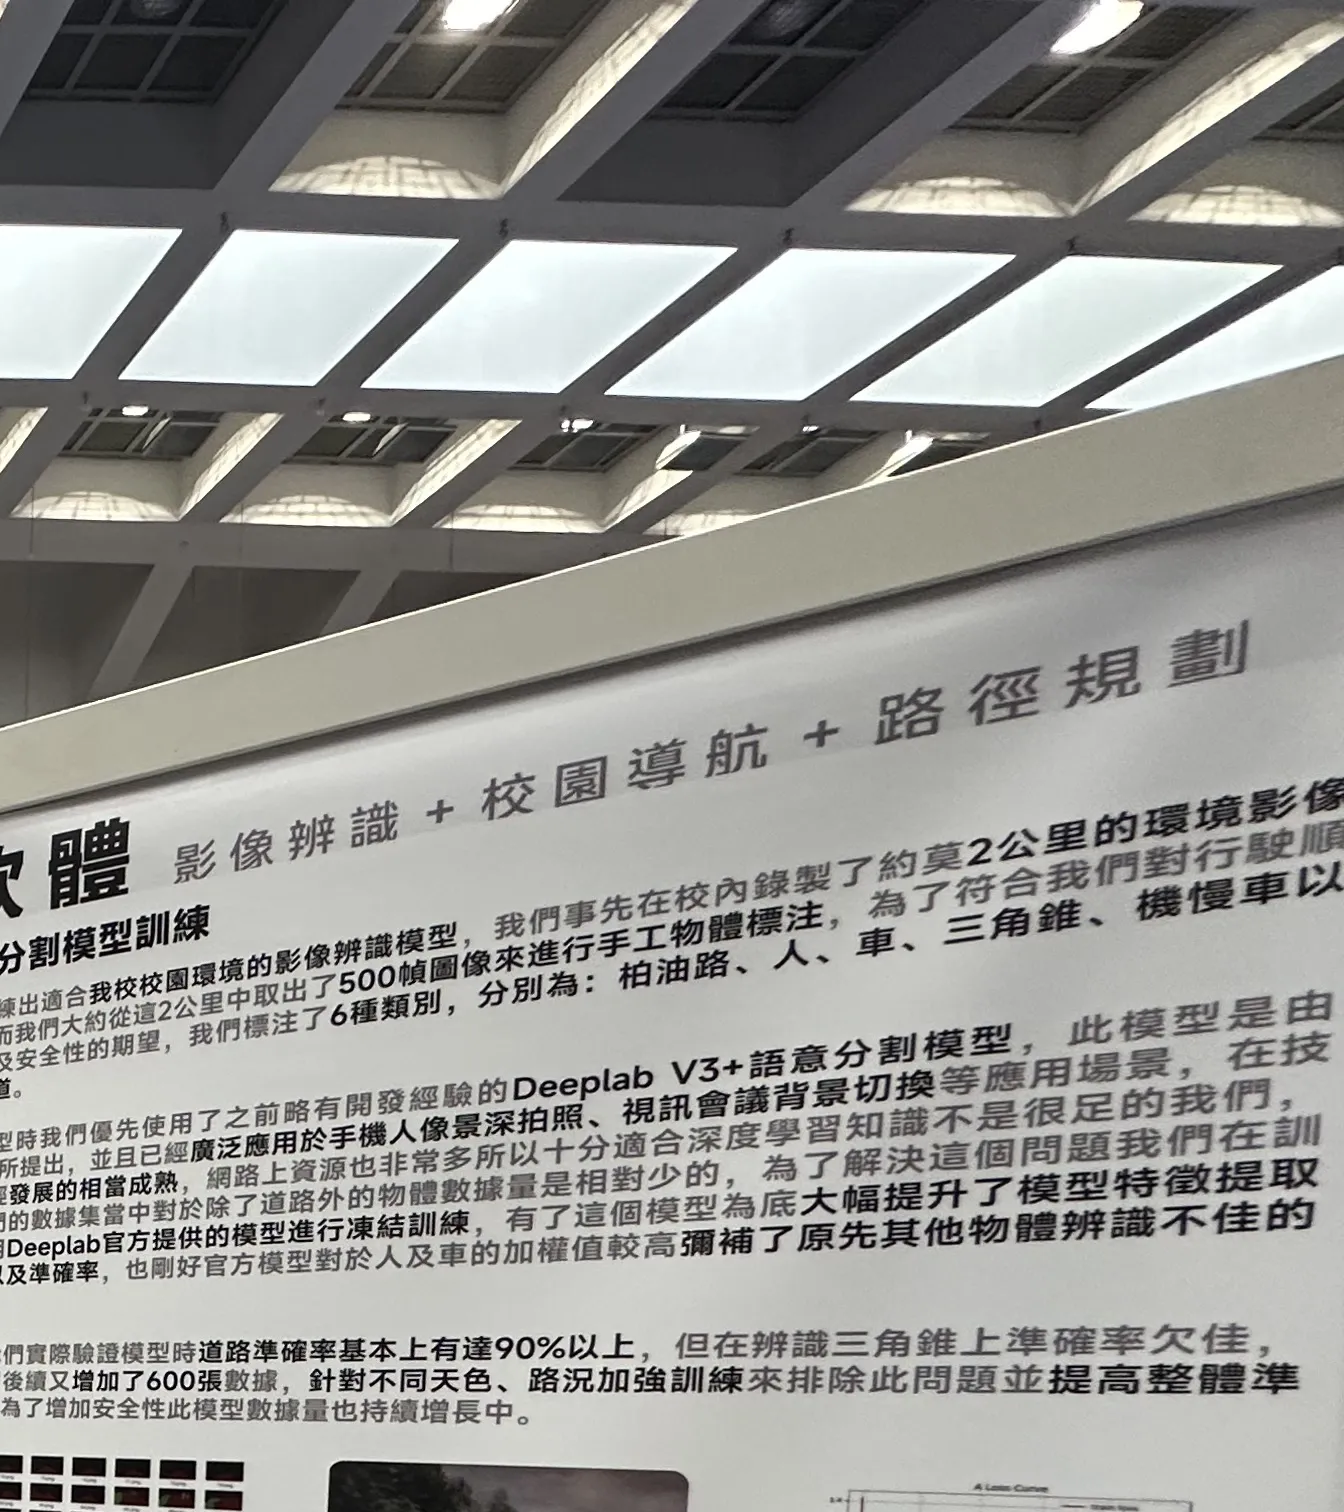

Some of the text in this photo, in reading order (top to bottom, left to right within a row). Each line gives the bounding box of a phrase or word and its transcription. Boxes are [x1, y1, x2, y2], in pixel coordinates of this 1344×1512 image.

[174, 799, 399, 888] 影像辨識
[483, 724, 769, 823] 校園導航
[873, 619, 1252, 746] 路徑規劃
